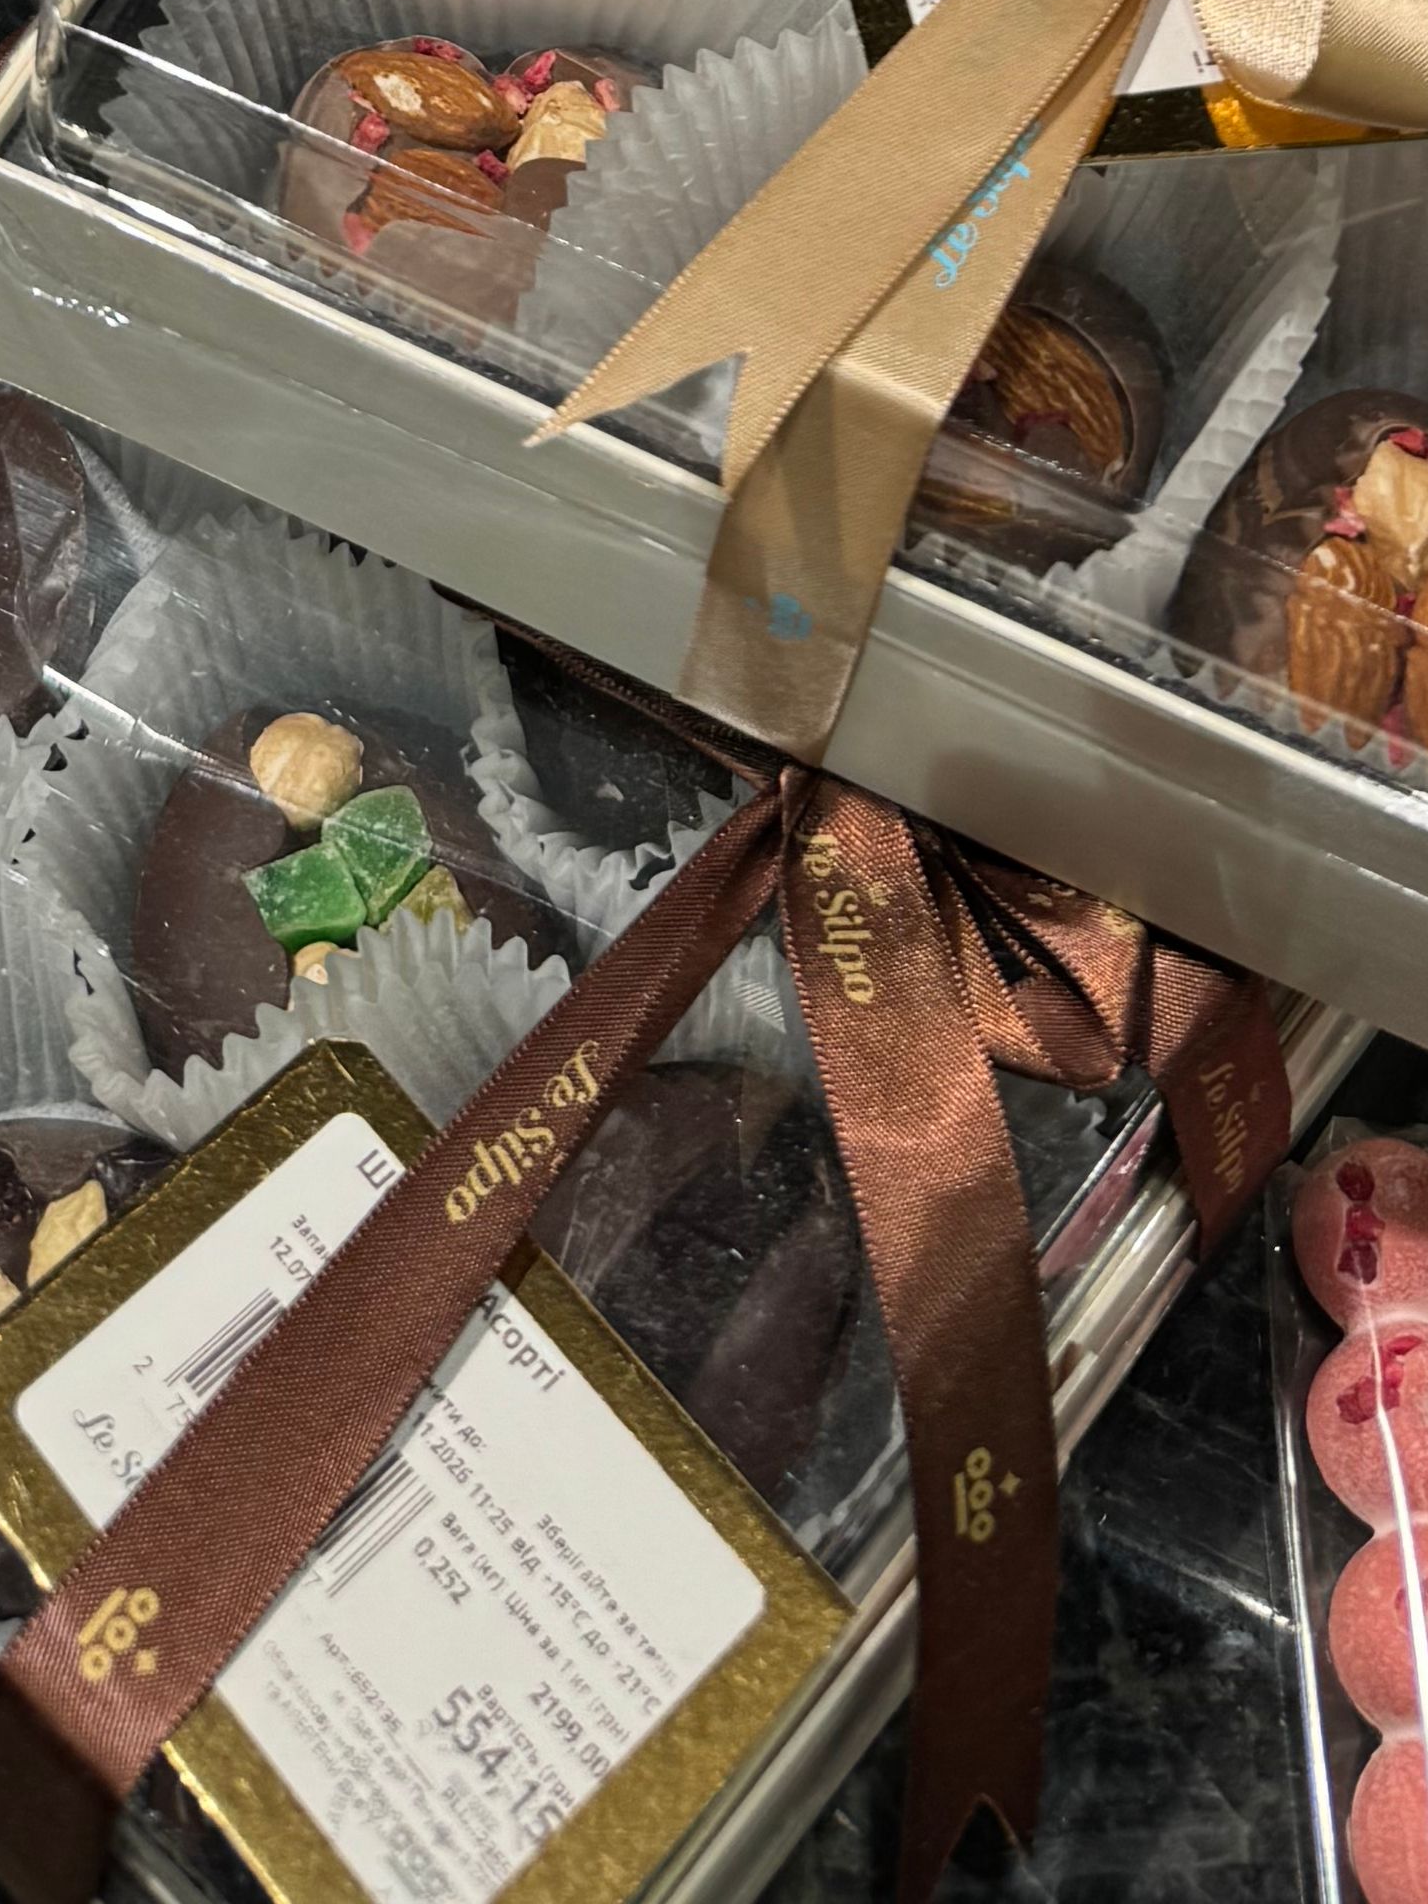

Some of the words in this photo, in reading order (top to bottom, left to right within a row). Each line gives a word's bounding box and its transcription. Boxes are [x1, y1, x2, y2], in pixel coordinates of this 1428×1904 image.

[814, 889, 875, 1005] Silpo
[543, 1040, 600, 1108] Le
[445, 1106, 557, 1224] Silpo
[133, 1355, 154, 1375] 2
[476, 1290, 568, 1395] Асорті
[72, 1408, 118, 1454] Le
[414, 1535, 473, 1607] 0,252
[440, 1512, 474, 1553] Вага
[431, 1685, 564, 1840] 554,15
[532, 1681, 611, 1780] 2199,00
